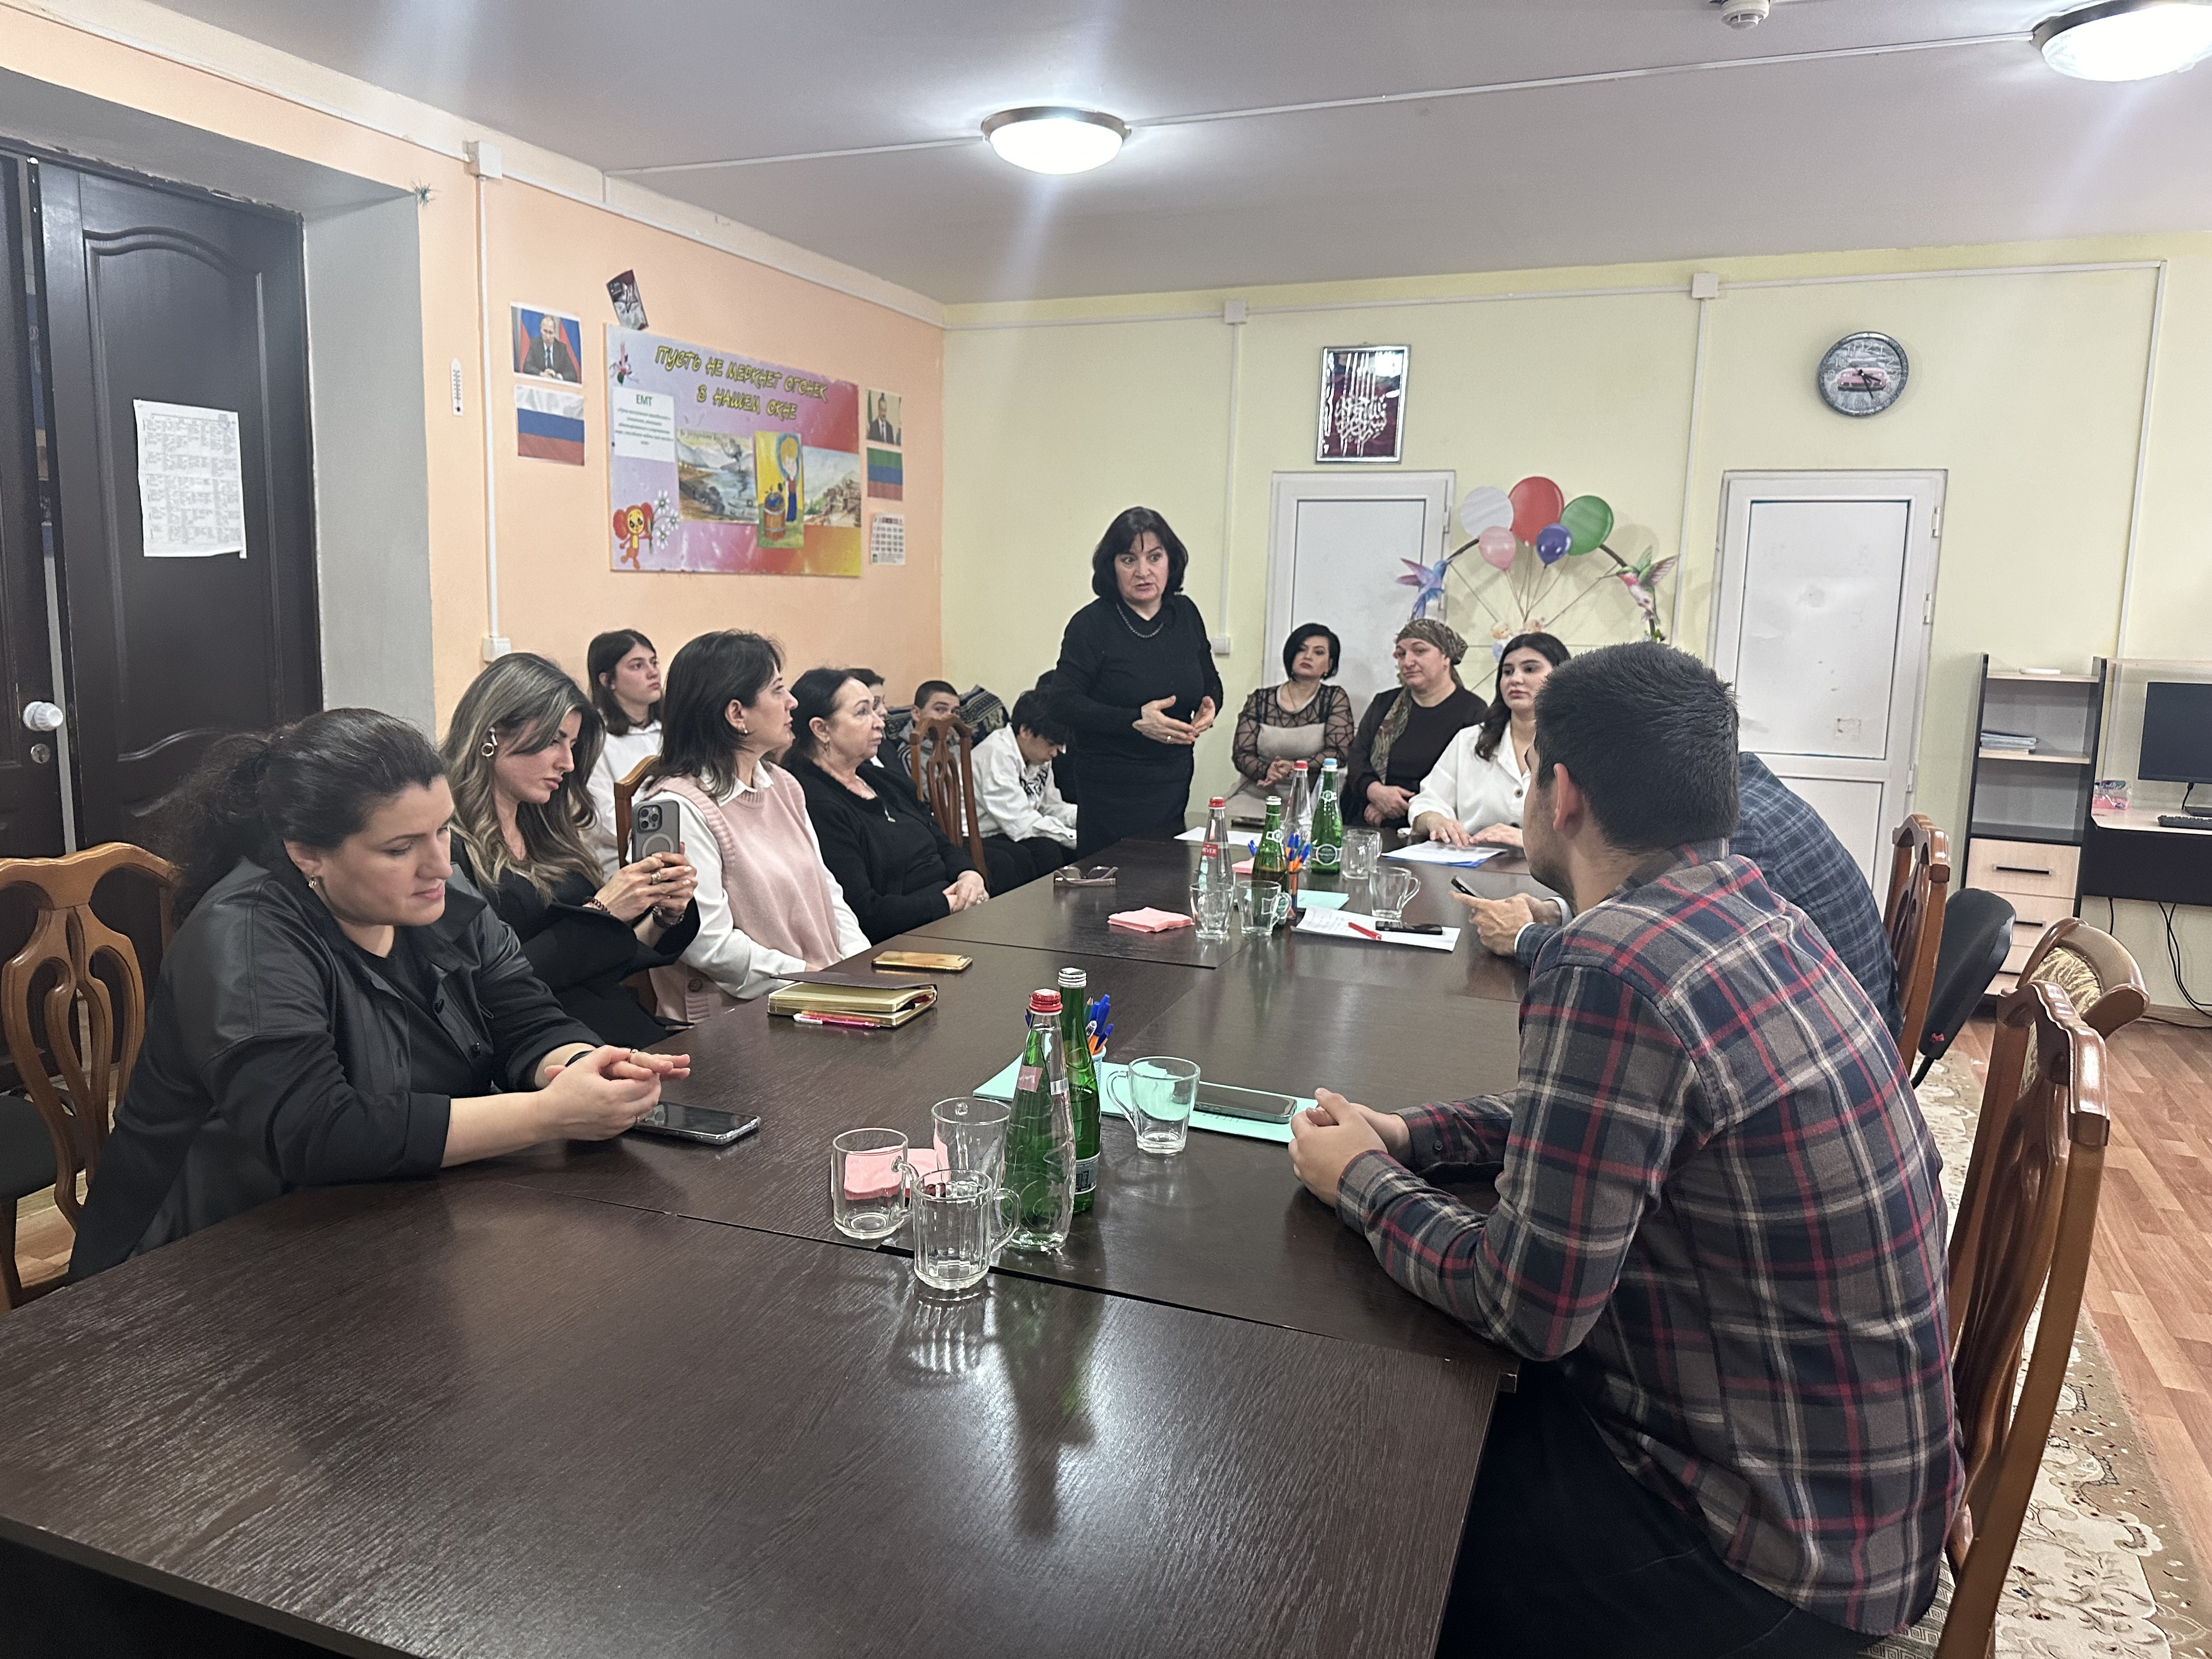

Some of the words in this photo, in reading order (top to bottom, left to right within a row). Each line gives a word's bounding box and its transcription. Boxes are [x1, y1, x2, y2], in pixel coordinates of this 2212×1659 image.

[654, 345, 702, 372] ПУСТЬ
[706, 356, 724, 377] НЕ
[725, 361, 783, 389] МЕРКНЕТ
[783, 375, 828, 403] ОГОНЕК
[696, 384, 707, 403] В
[712, 387, 761, 415] НАШЕМ
[766, 399, 798, 421] ОКНЕ
